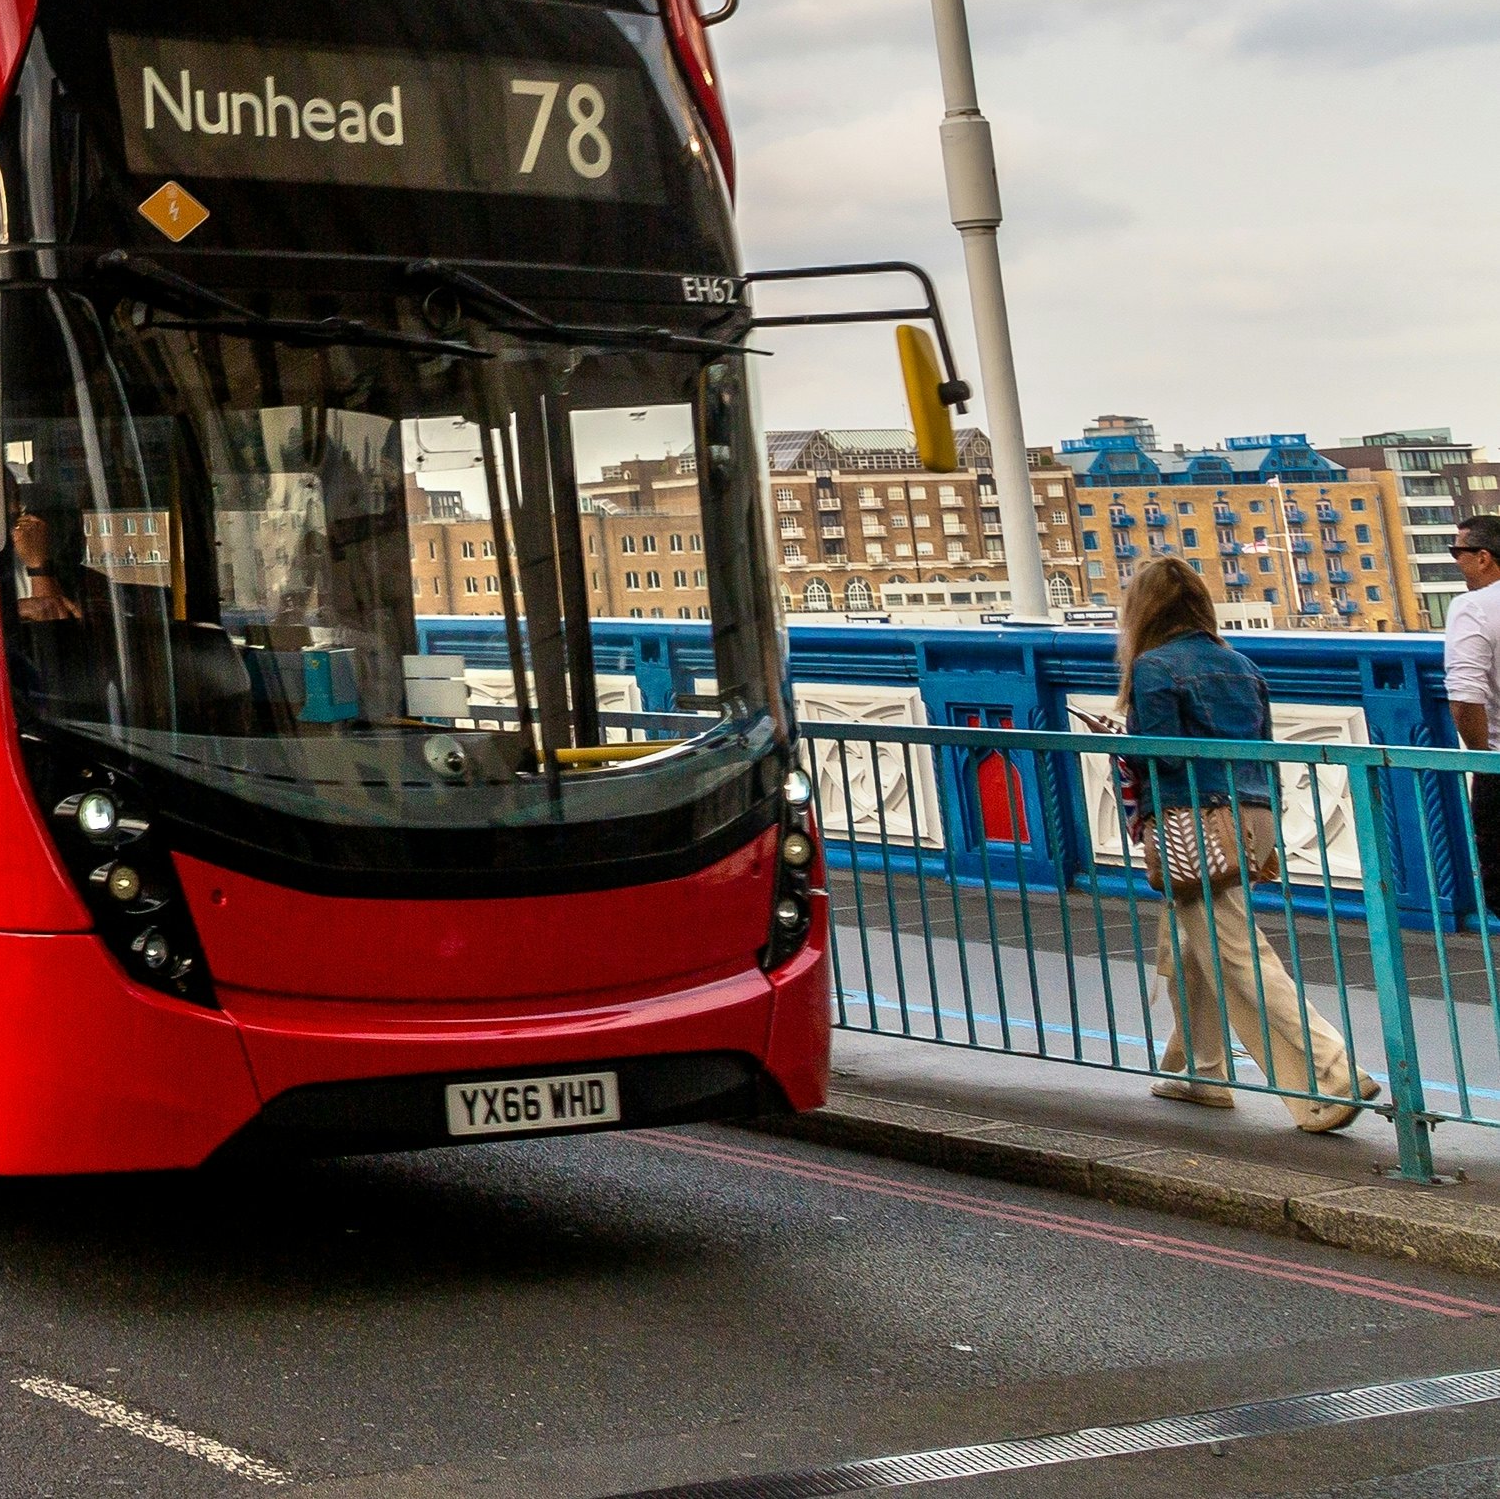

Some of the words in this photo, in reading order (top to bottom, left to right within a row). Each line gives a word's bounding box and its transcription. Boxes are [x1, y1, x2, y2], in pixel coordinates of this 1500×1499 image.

[143, 66, 403, 147] Nunhead
[510, 78, 612, 180] 78
[681, 277, 738, 303] EH62
[460, 1085, 541, 1126] YX66
[548, 1080, 605, 1119] WHD
